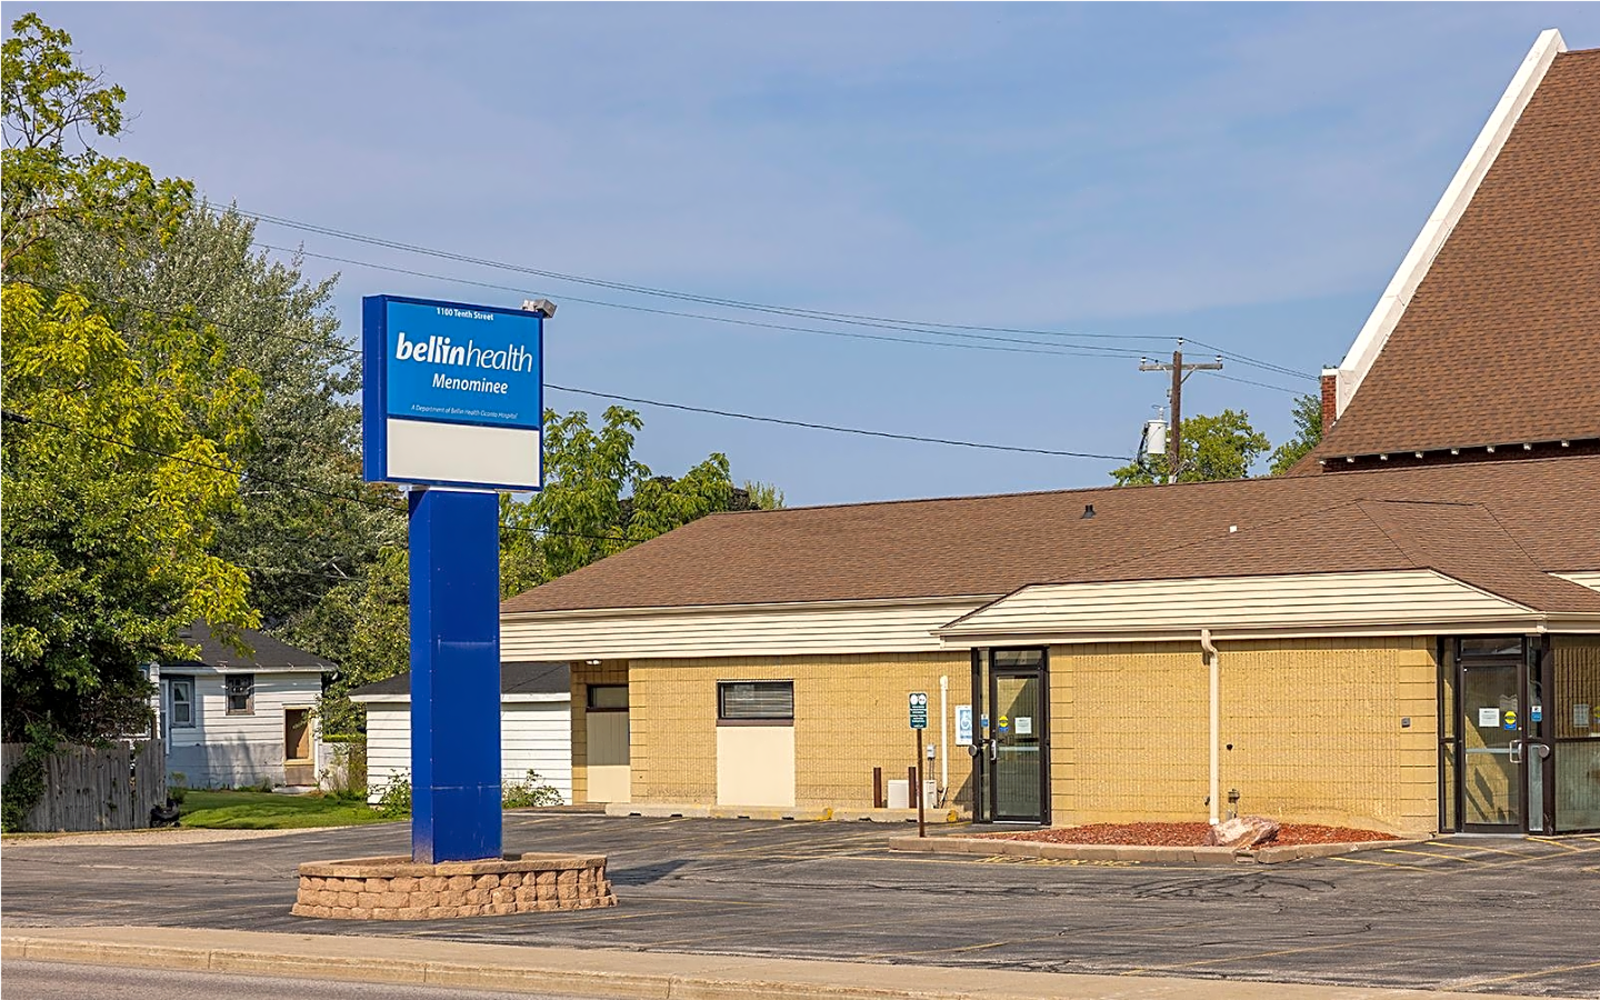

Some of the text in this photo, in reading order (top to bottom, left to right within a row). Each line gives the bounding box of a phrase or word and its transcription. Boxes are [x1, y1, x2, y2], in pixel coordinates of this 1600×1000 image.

[454, 309, 473, 319] Tenth
[473, 311, 494, 321] Street
[432, 373, 509, 394] Menominee
[416, 404, 445, 413] Department
[445, 406, 451, 414] of
